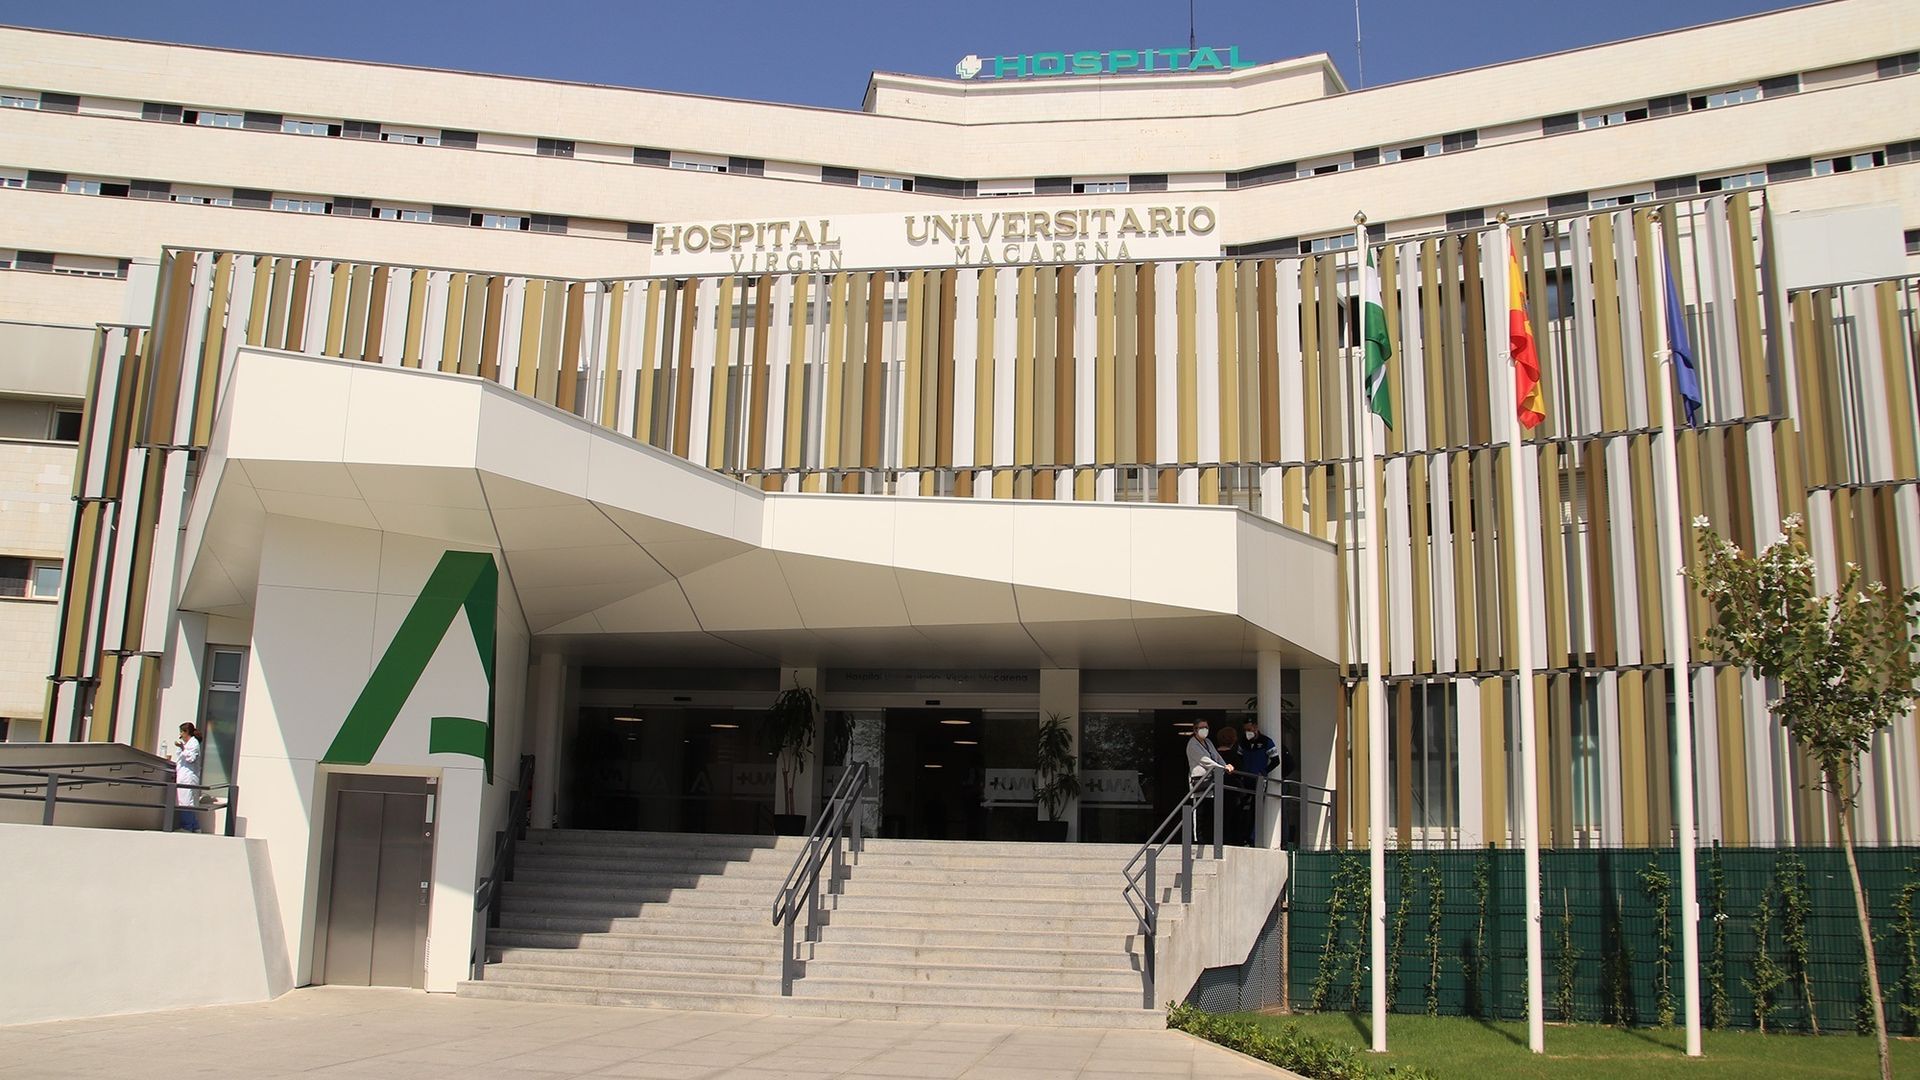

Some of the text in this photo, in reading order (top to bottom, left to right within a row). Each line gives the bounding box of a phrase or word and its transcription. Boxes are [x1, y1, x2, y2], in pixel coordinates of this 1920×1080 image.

[994, 45, 1256, 79] HOSPITAL
[654, 206, 1216, 255] HOSPITAL UNIVERSITARIO
[730, 240, 1131, 273] VIRGEN MACARENA
